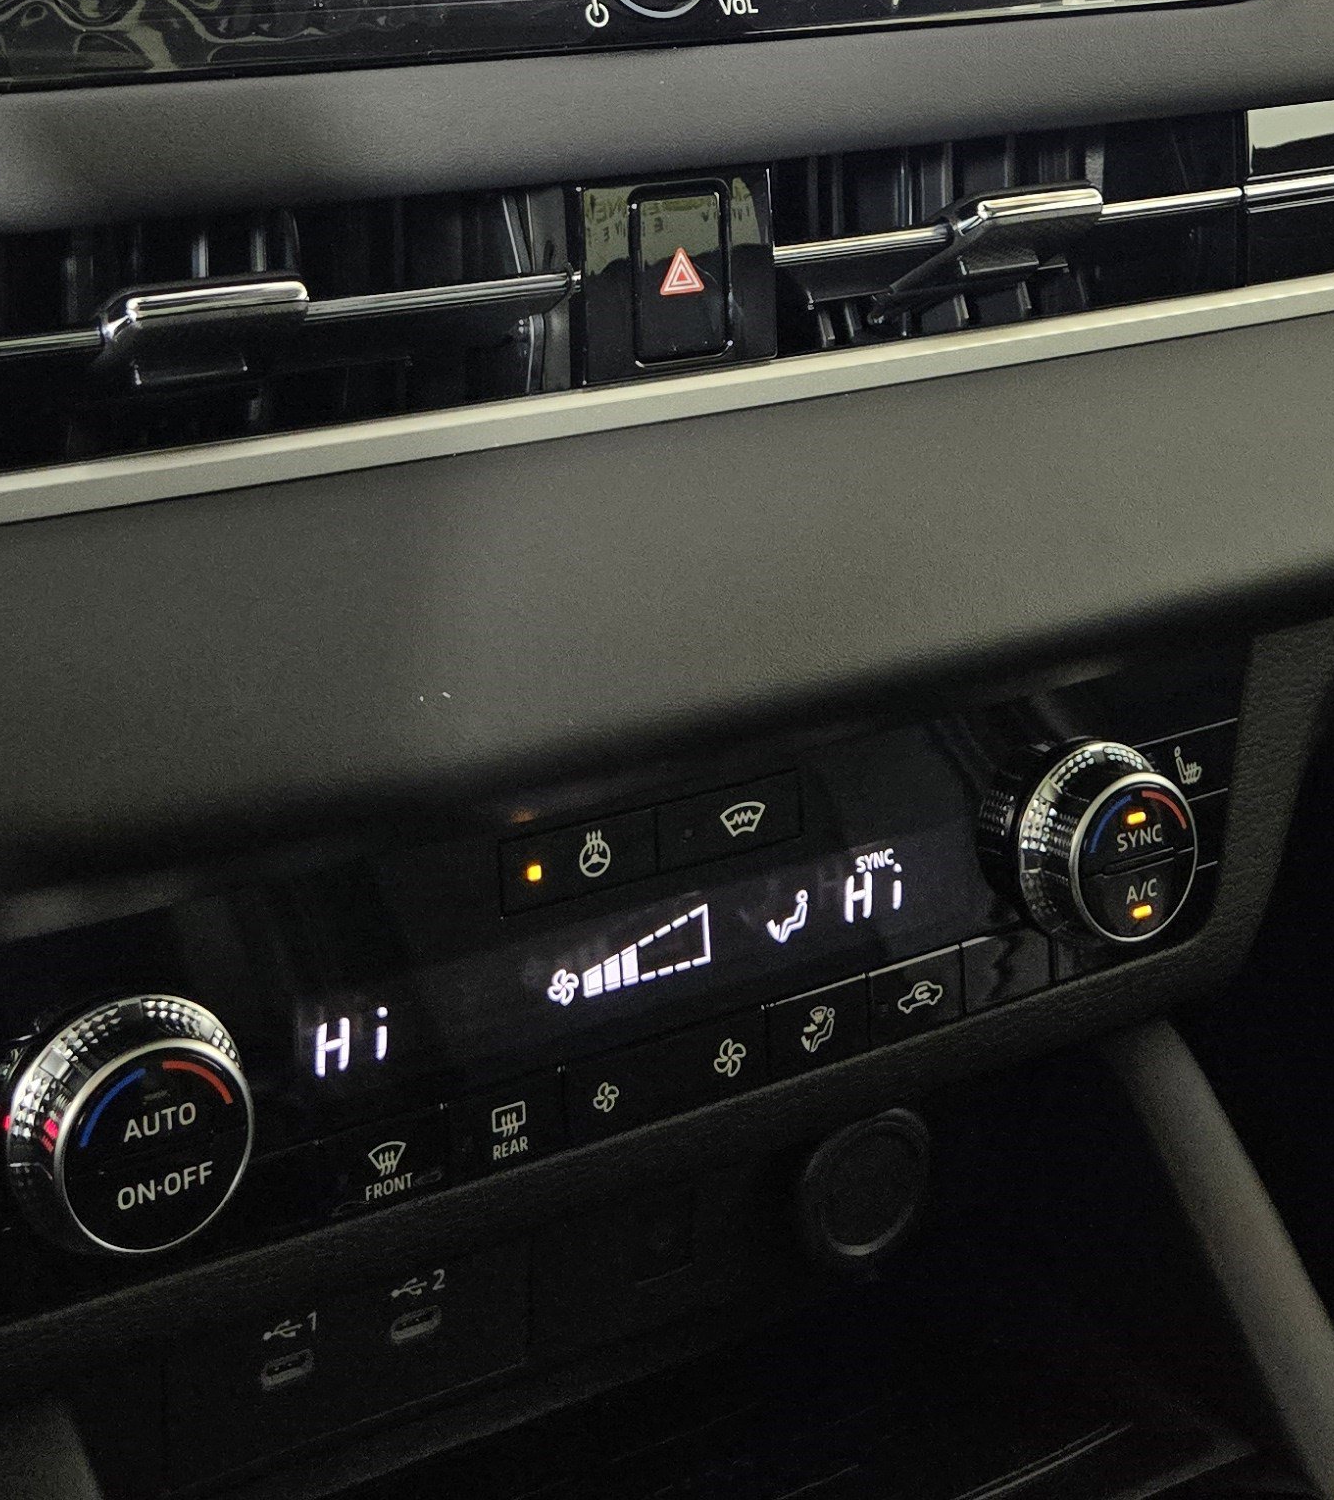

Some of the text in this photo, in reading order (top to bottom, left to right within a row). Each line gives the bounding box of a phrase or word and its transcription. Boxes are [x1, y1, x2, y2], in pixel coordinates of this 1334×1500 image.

[1115, 822, 1164, 852] SYNC
[855, 848, 896, 874] SYNC
[843, 862, 903, 924] Hi
[1125, 877, 1159, 905] A/C
[313, 1006, 389, 1078] Hi
[122, 1101, 198, 1144] AUTO
[491, 1135, 529, 1161] REAR
[364, 1171, 415, 1203] FRONT
[431, 1269, 446, 1291] 2
[307, 1311, 319, 1333] 1
